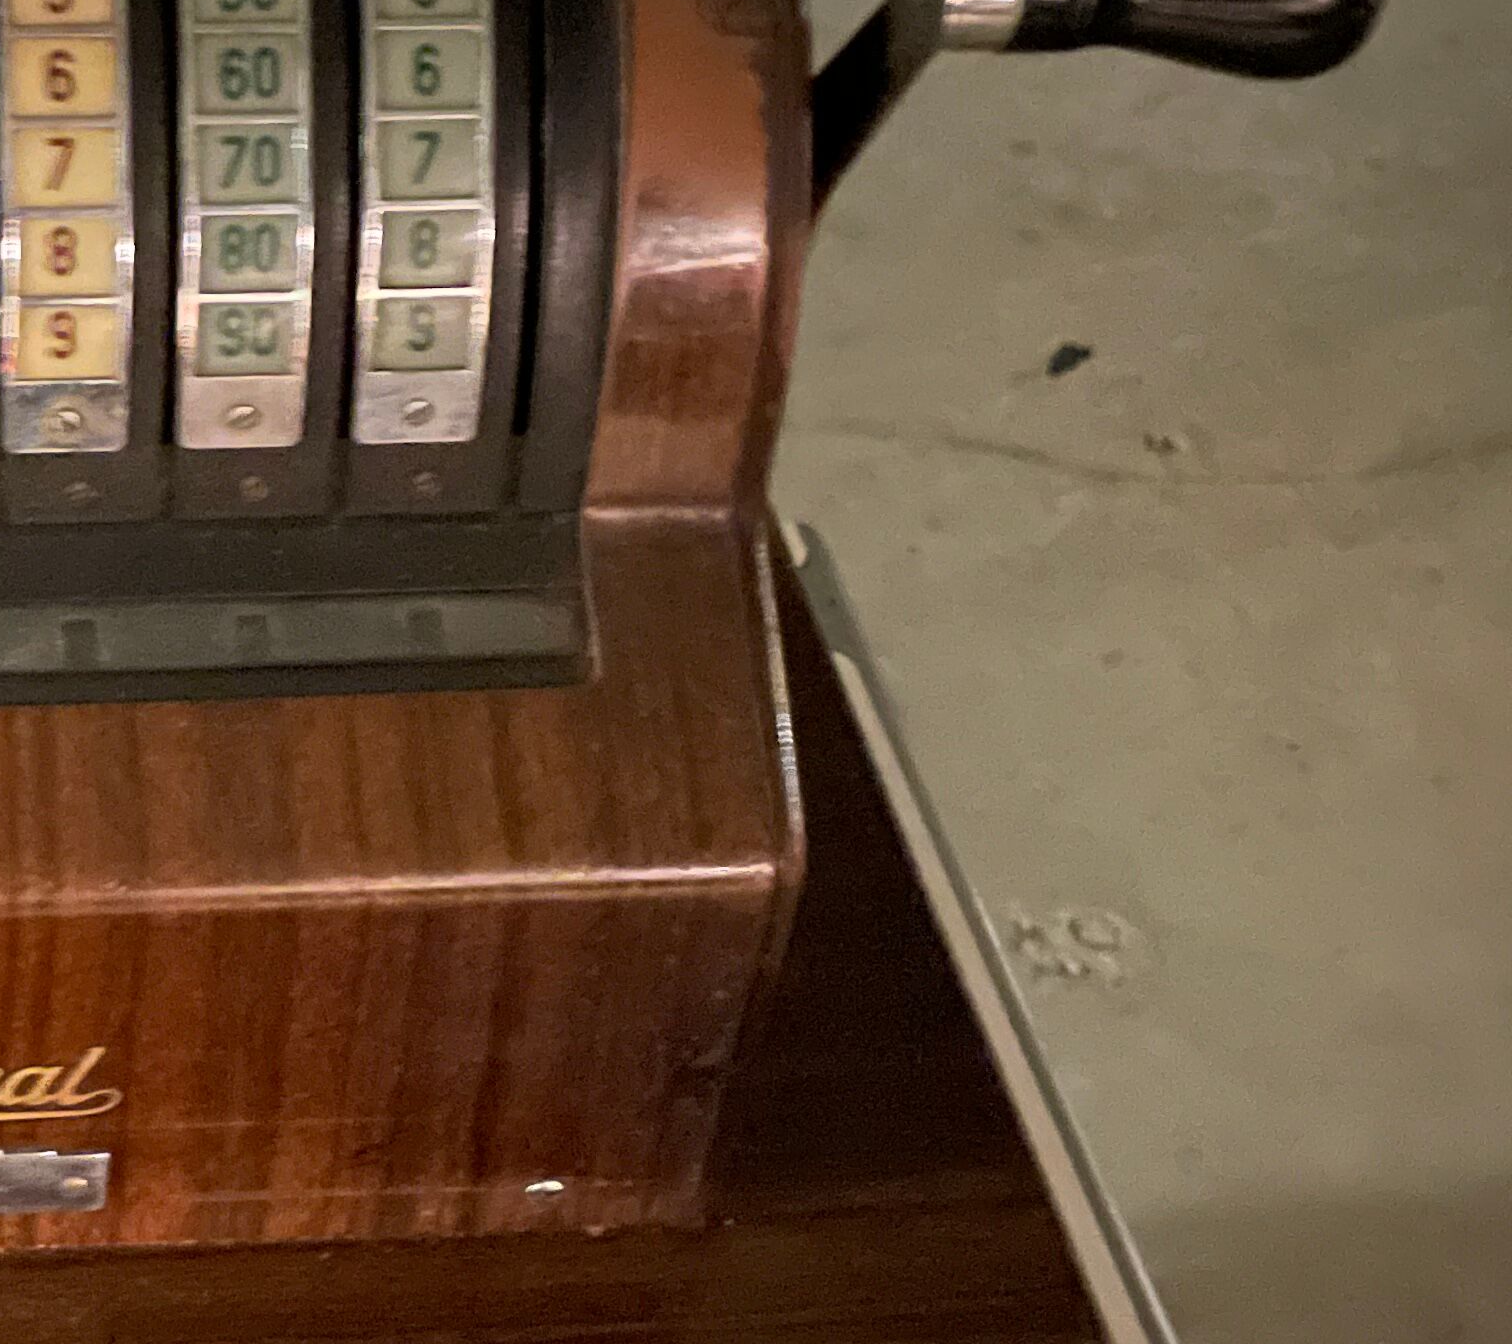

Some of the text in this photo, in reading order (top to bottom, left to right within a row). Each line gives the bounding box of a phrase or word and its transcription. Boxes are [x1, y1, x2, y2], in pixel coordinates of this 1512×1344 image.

[45, 49, 76, 102] 6
[217, 47, 281, 100] 60
[410, 43, 441, 97] 6
[42, 138, 75, 191] 7
[218, 135, 282, 189] 70
[410, 131, 442, 184] 7
[46, 226, 76, 276] 8
[218, 223, 280, 274] 80
[408, 219, 439, 270] 8
[46, 310, 76, 359] 9
